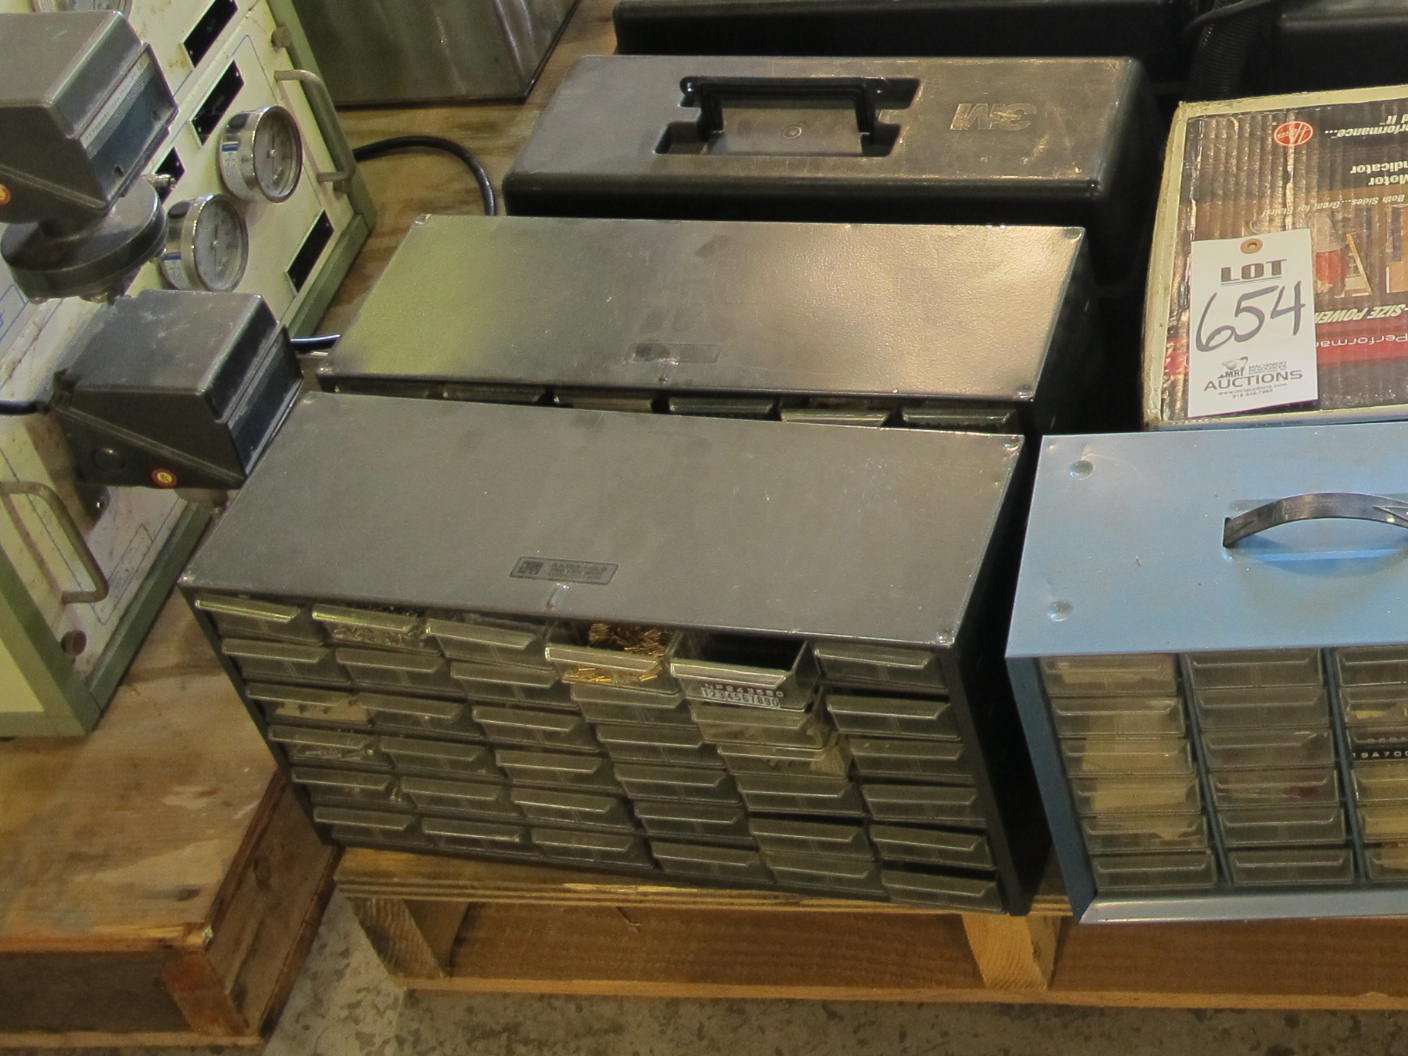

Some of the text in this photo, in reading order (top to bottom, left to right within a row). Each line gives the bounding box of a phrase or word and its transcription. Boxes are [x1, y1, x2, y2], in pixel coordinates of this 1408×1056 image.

[1220, 259, 1287, 282] LOT
[1195, 280, 1306, 353] 654
[1314, 330, 1408, 348] Performa
[1203, 369, 1304, 392] AUCTIONS
